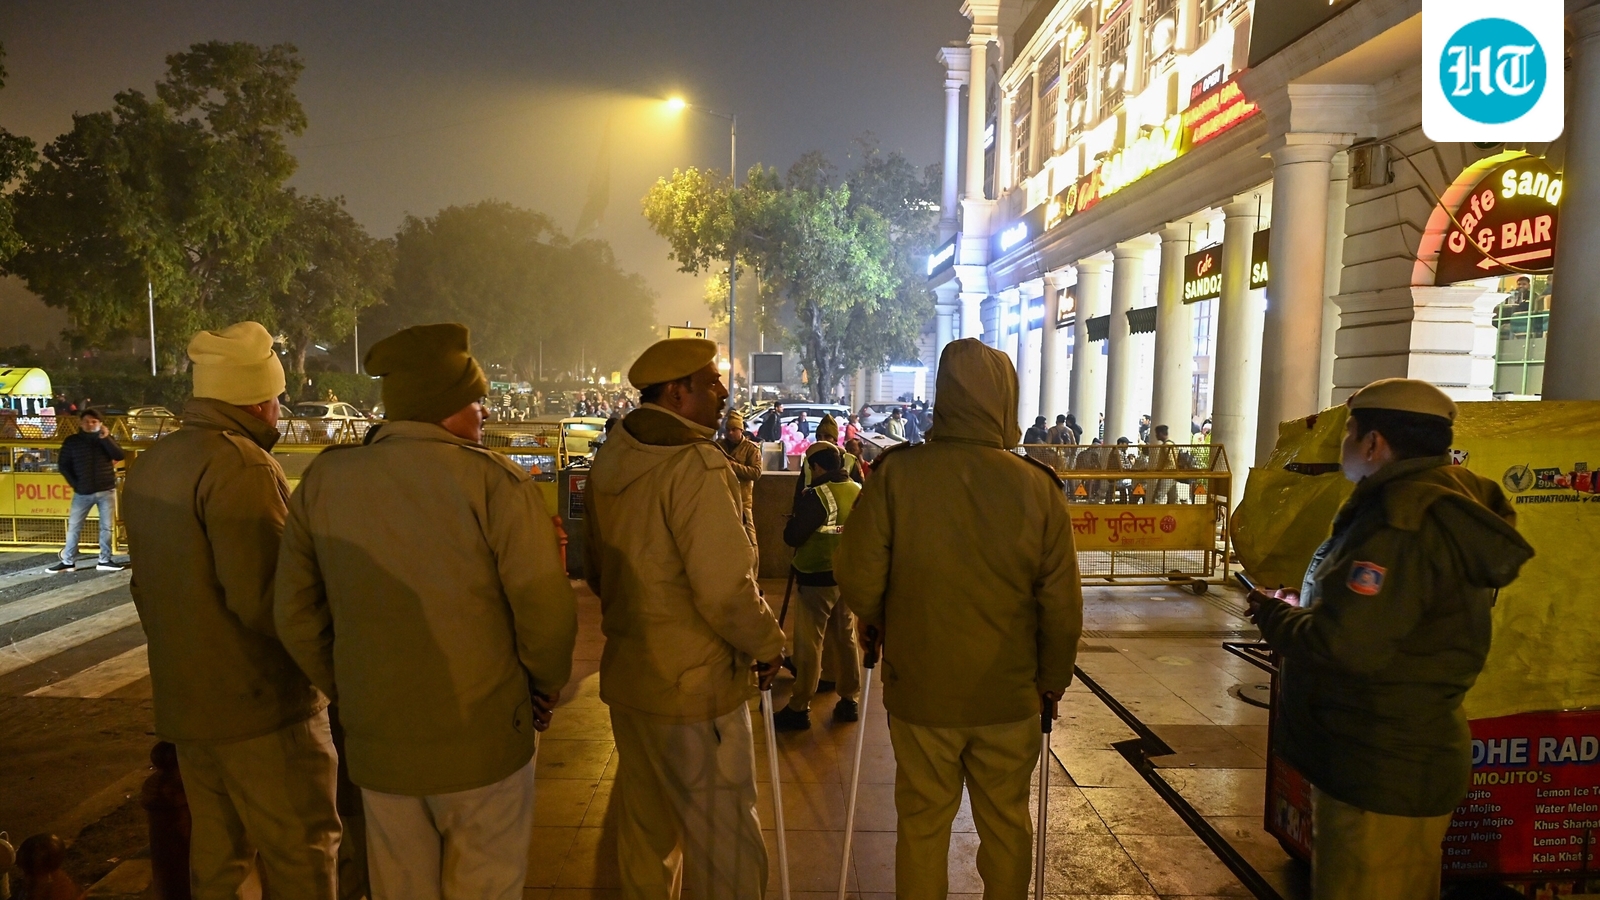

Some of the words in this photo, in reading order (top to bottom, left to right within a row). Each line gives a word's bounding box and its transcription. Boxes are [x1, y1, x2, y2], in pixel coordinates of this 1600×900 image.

[1476, 228, 1496, 253] &
[1501, 214, 1552, 250] BAR
[1197, 254, 1212, 276] Cafe
[1252, 261, 1268, 283] SA
[1185, 274, 1222, 299] SANDOZ
[16, 483, 72, 500] POLICE
[1516, 495, 1580, 504] INTERNATIONAL
[1105, 511, 1156, 542] पुलिस
[1538, 736, 1599, 762] RAD
[1473, 771, 1551, 785] MOJITO's
[1466, 790, 1491, 800] ojito
[1536, 788, 1570, 798] Lemon
[1574, 786, 1589, 796] Ice
[1470, 804, 1501, 815] Mojito
[1535, 804, 1565, 814] Water
[1568, 803, 1598, 812] Melon
[1482, 817, 1514, 828] Mojito
[1534, 820, 1560, 830] Khus
[1470, 832, 1502, 842] Mojito
[1533, 837, 1567, 846] Lemon
[1570, 835, 1596, 844] Doa
[1533, 853, 1556, 862] Kala
[1558, 852, 1593, 861] Khata
[1452, 861, 1488, 870] Masala
